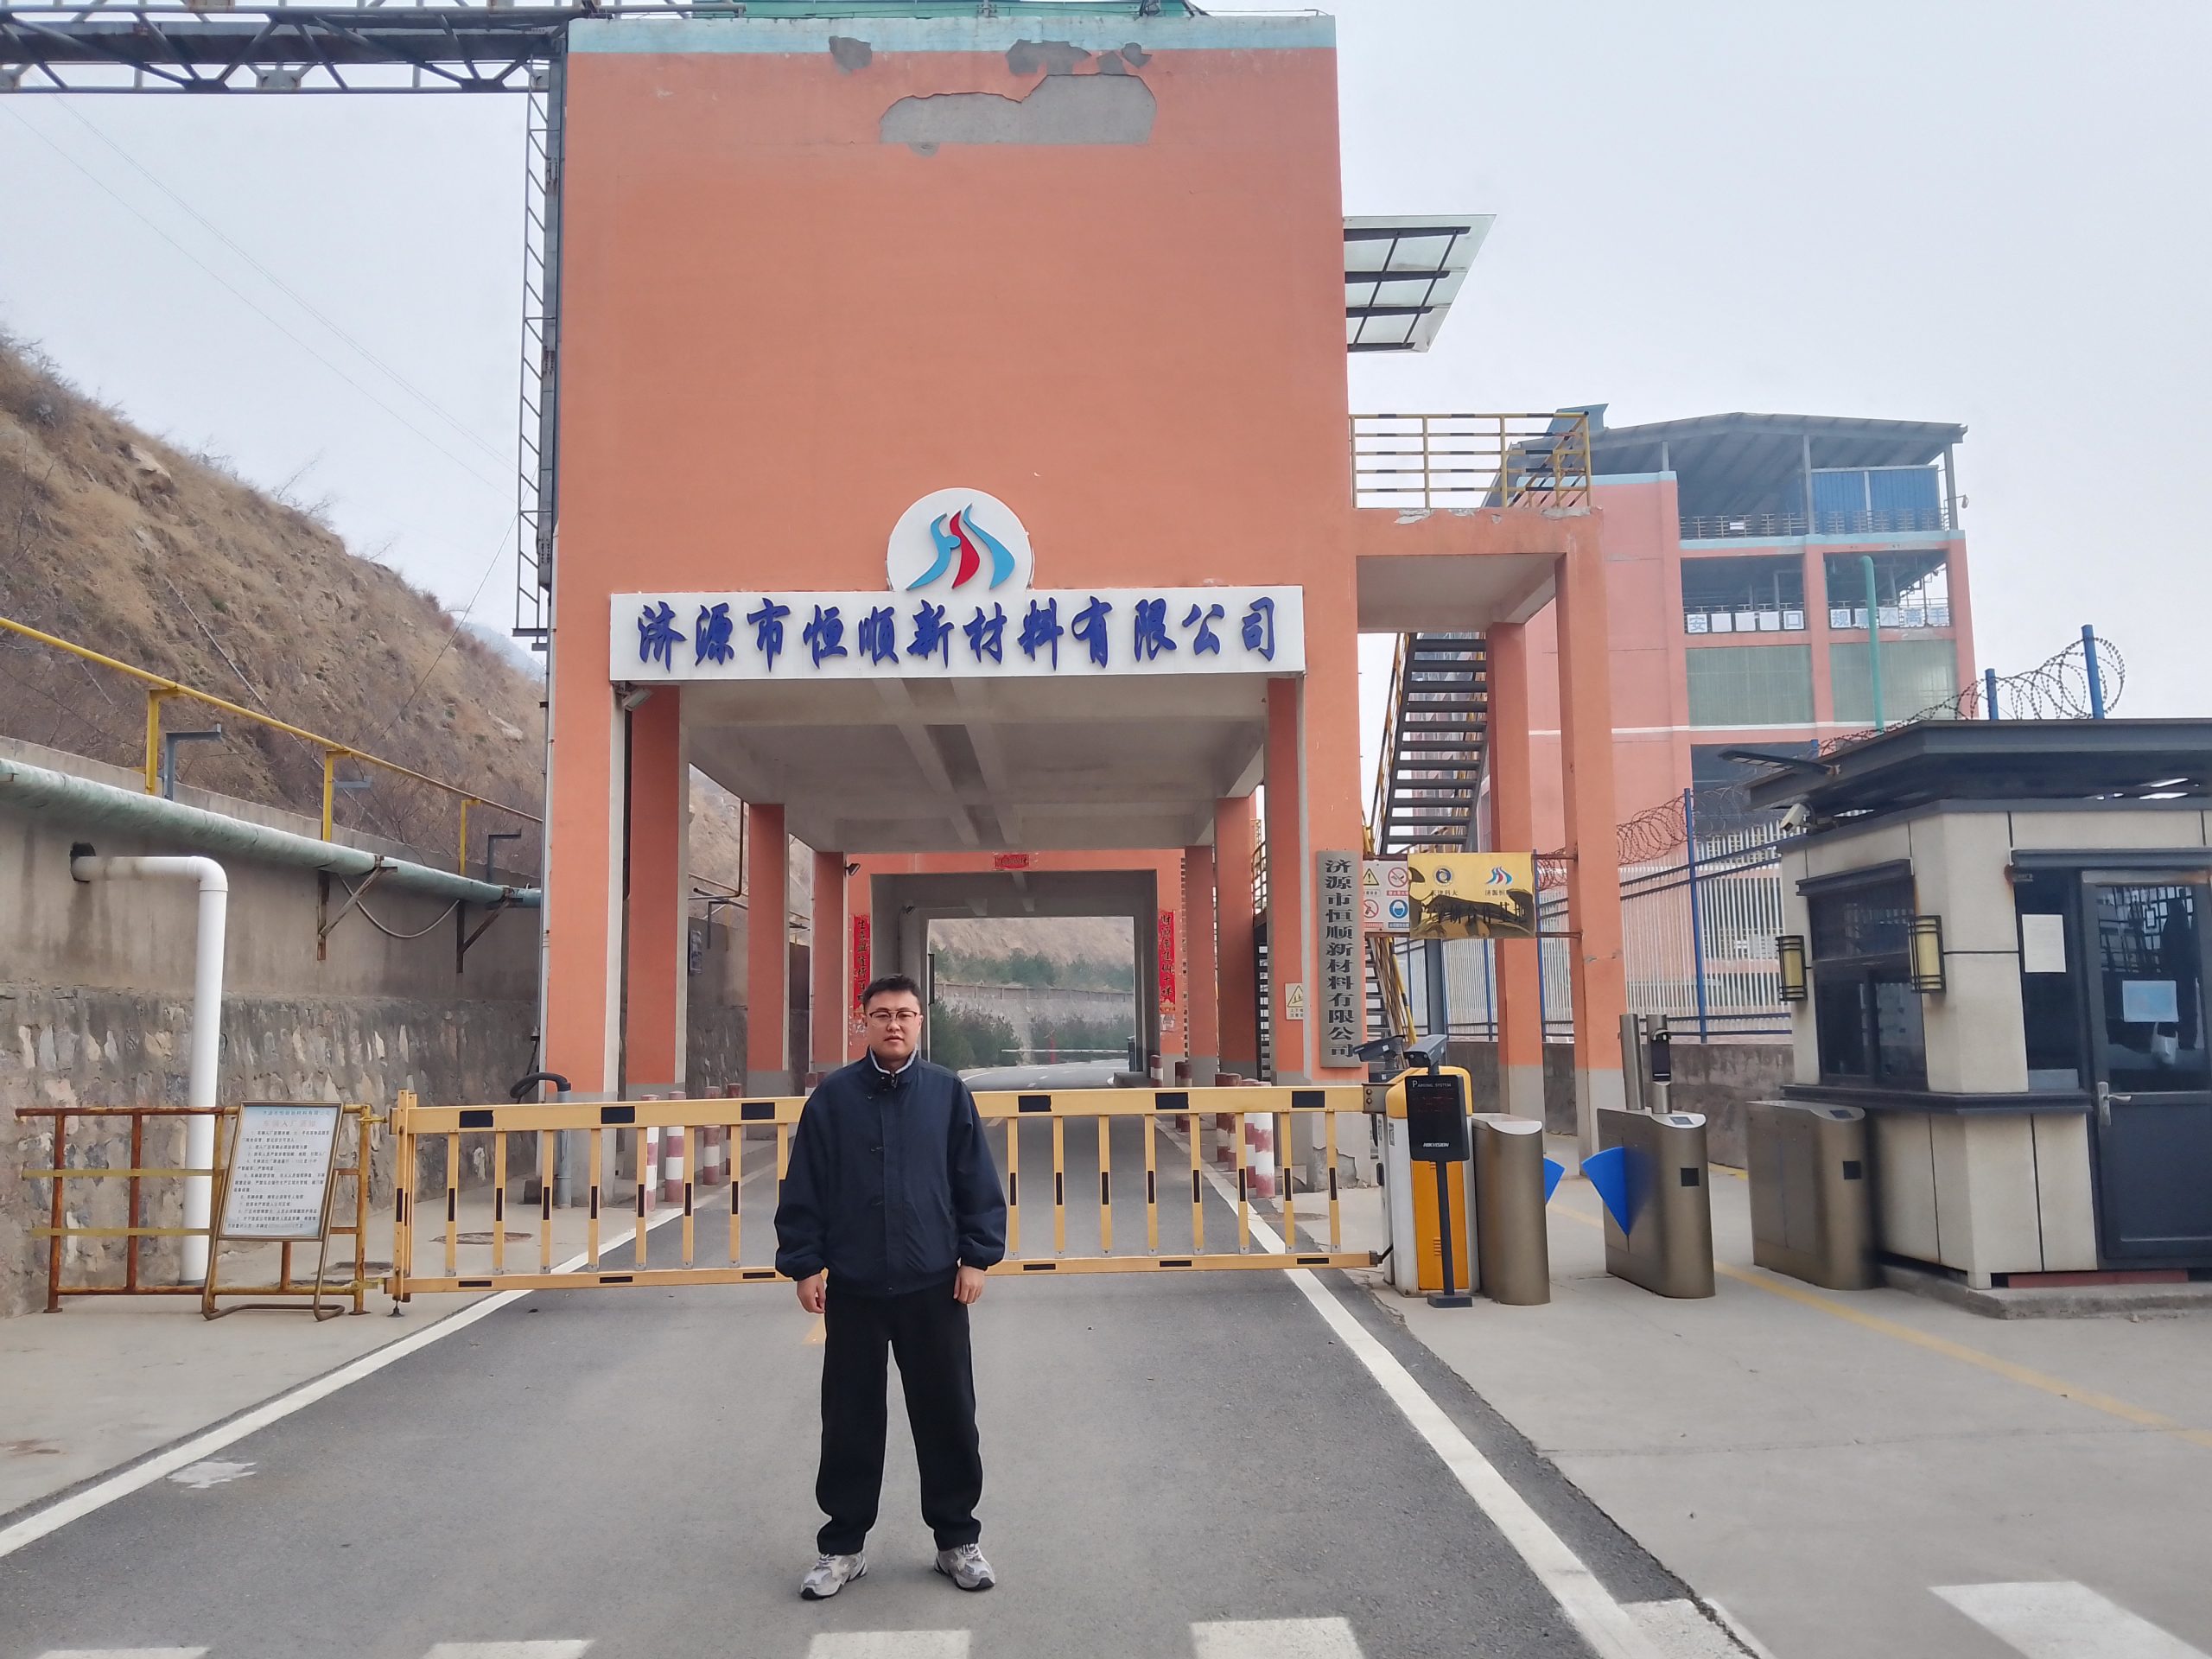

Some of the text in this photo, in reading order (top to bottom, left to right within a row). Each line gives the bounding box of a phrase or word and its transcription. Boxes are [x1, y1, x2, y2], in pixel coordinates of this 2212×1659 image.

[638, 596, 1276, 672] 济源市恒顺新材料有限公司
[1325, 859, 1355, 1058] 济源市恒顺新材料有限公司
